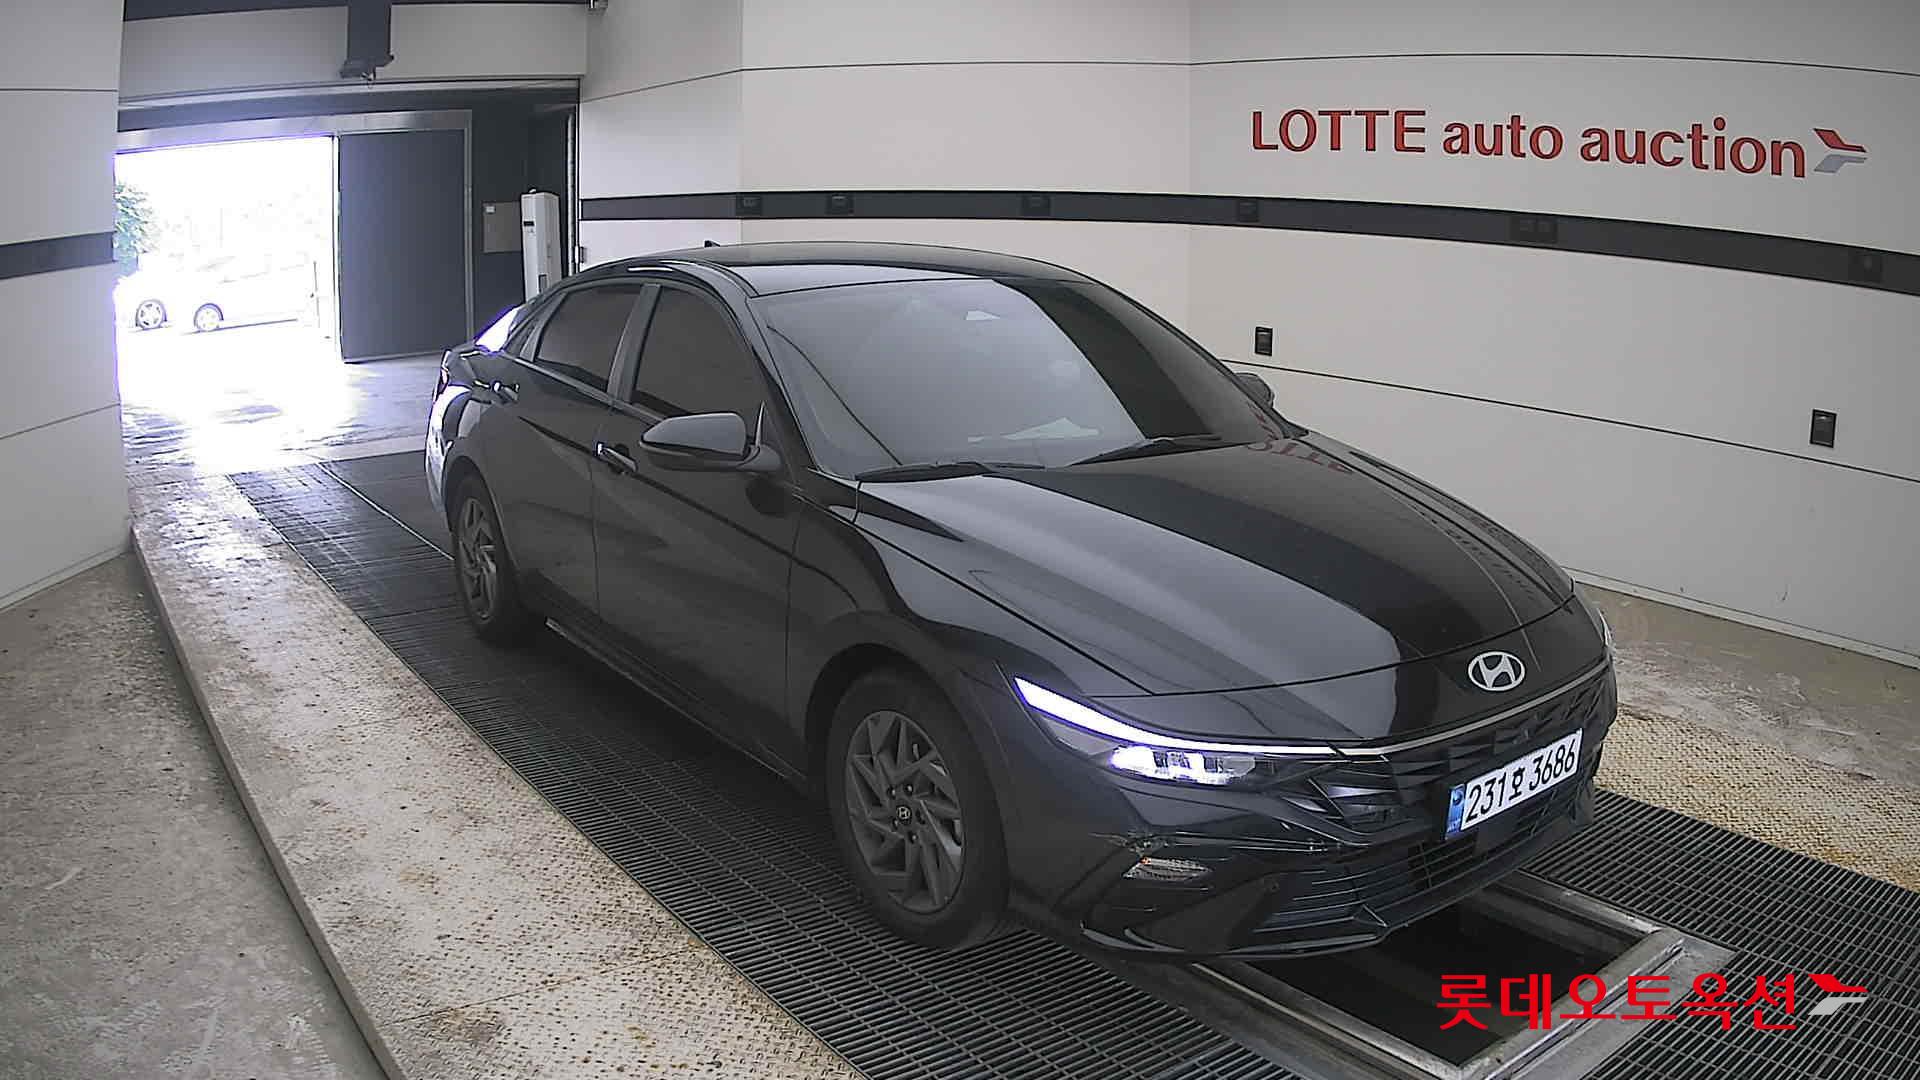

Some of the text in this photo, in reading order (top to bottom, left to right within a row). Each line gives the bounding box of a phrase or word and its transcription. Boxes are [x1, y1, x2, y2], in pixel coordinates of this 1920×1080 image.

[1251, 110, 1808, 179] LOTTE auto auction
[1465, 738, 1576, 823] 231호 3686
